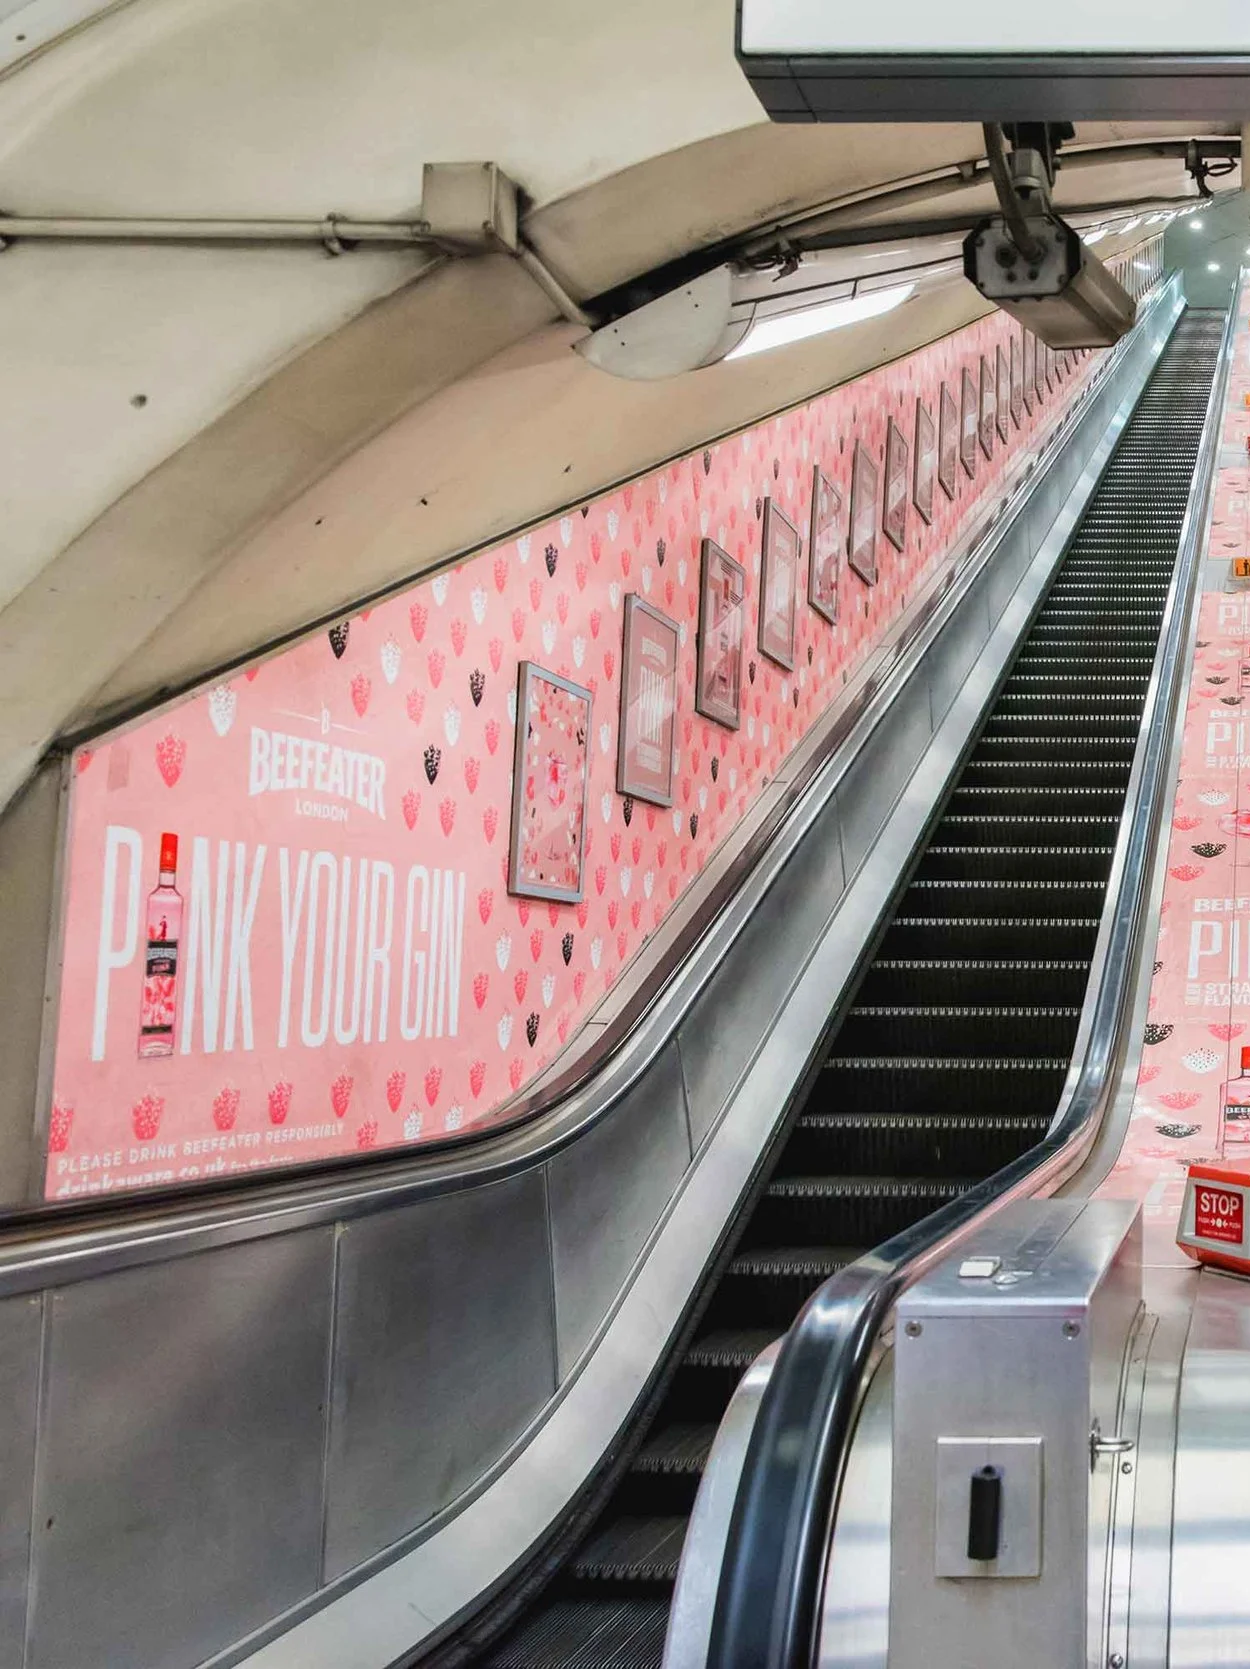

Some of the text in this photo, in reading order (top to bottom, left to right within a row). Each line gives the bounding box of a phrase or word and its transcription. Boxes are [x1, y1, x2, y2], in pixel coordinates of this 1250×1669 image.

[249, 726, 386, 820] BEEFEATER
[295, 798, 348, 822] LONDON
[278, 847, 395, 1048] YOUR
[400, 865, 466, 1041] GIN
[57, 1121, 345, 1176] PLEASE DRINK BEEFEATER RESPONSIBLY
[1200, 1192, 1239, 1216] STOP
